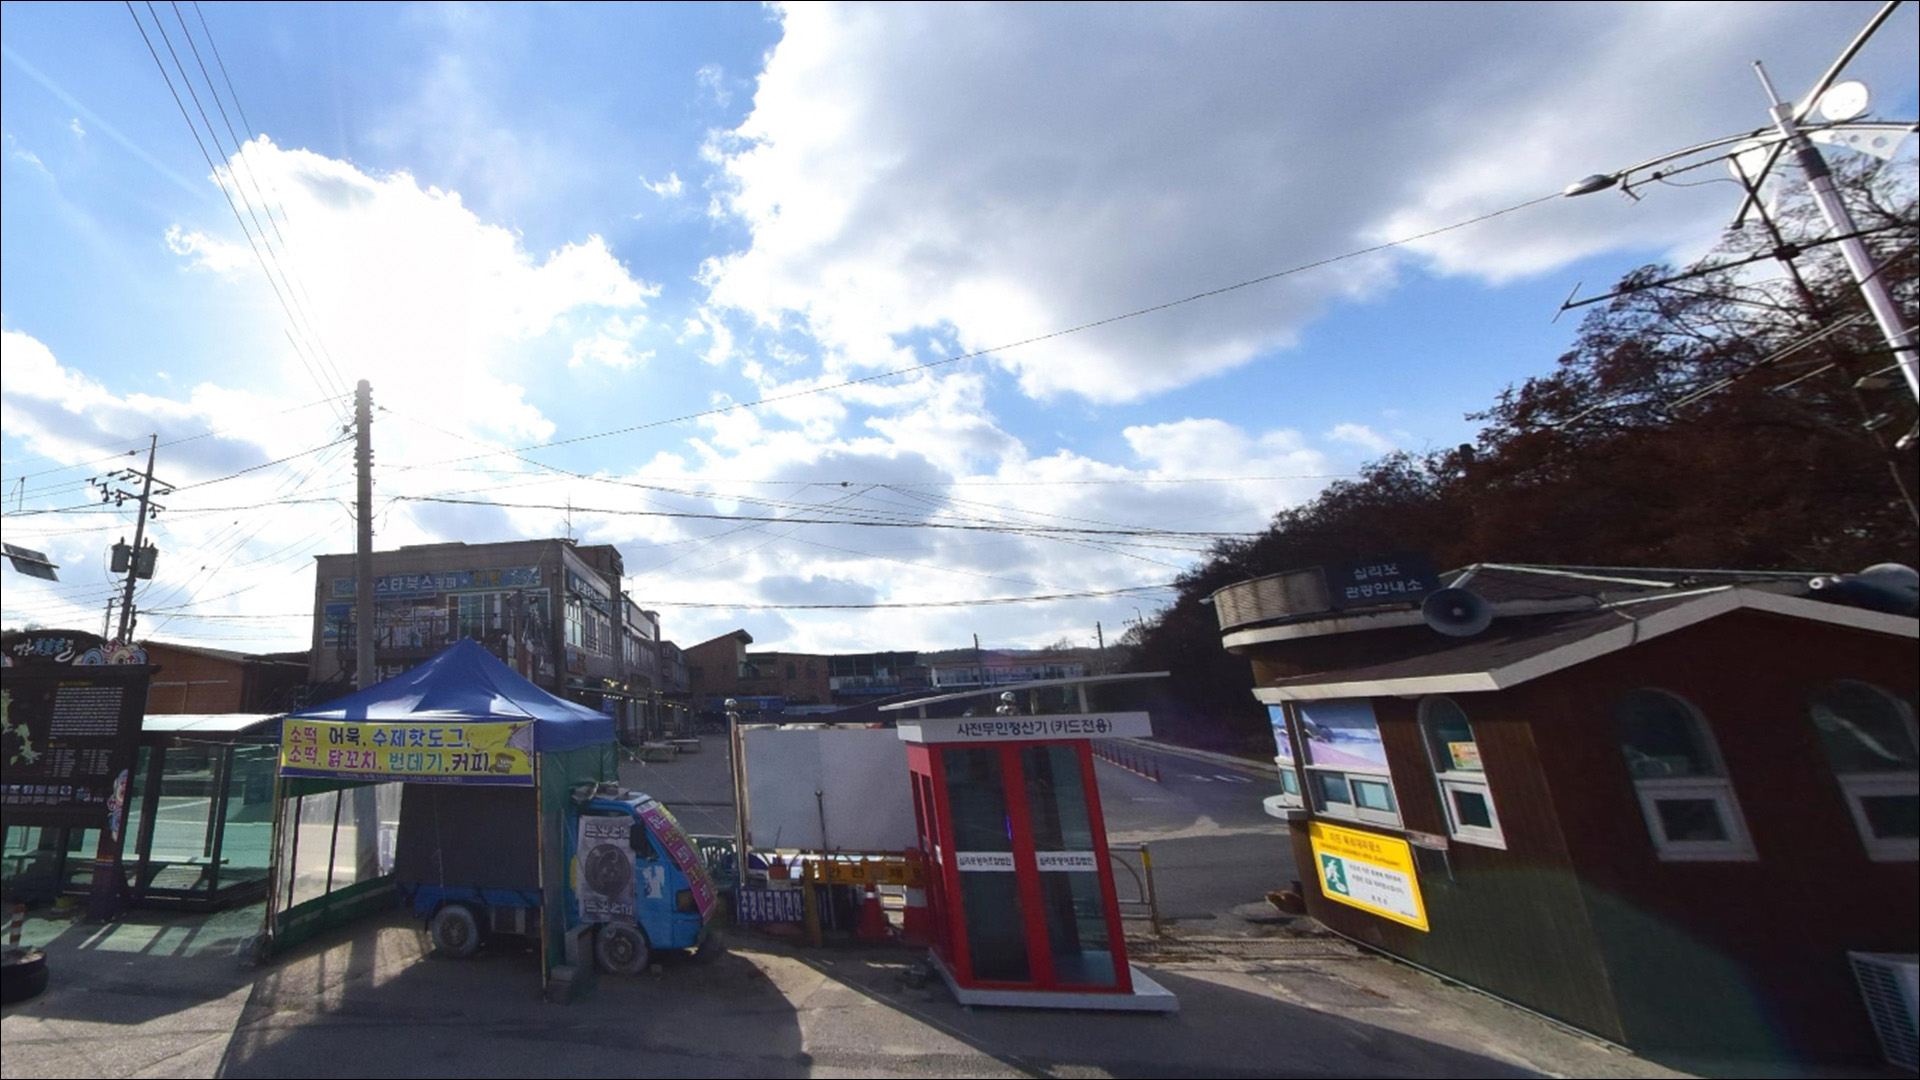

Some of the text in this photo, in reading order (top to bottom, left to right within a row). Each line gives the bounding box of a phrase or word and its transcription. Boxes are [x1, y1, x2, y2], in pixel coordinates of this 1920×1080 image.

[1353, 562, 1400, 580] 십리포
[1345, 579, 1424, 599] 관광안내소
[957, 718, 1114, 737] 사전무인정산기 (카드전용)
[290, 726, 472, 749] 소떡 어묵, 수제핫도그,
